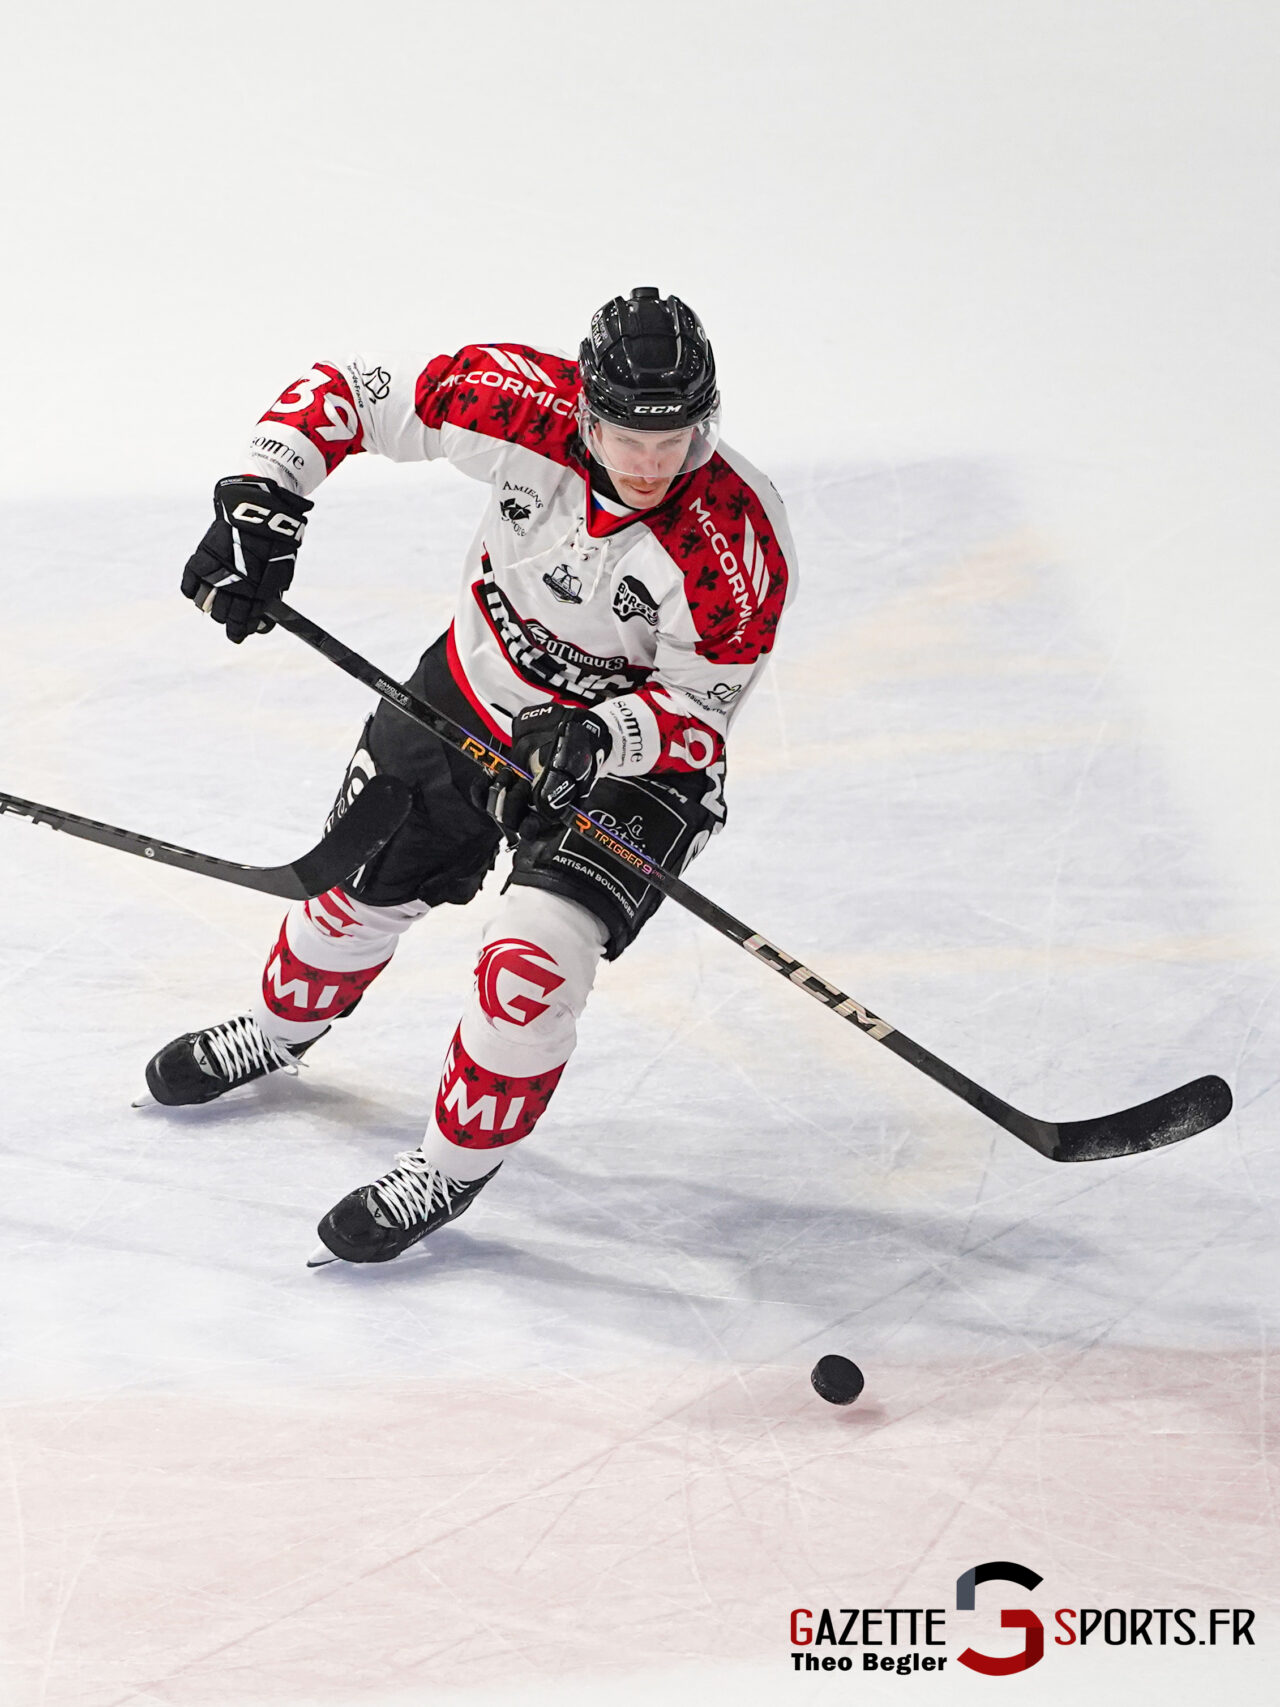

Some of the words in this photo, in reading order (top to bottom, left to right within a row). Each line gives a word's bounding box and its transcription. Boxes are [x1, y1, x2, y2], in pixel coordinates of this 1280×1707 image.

[270, 367, 359, 442] 39
[633, 404, 683, 414] CCM
[520, 706, 553, 721] CCM
[612, 699, 644, 764] somme
[594, 828, 643, 869] TRIGGER
[552, 853, 596, 878] ARTISAN
[594, 872, 636, 919] BOULANGER
[742, 933, 896, 1041] CCM
